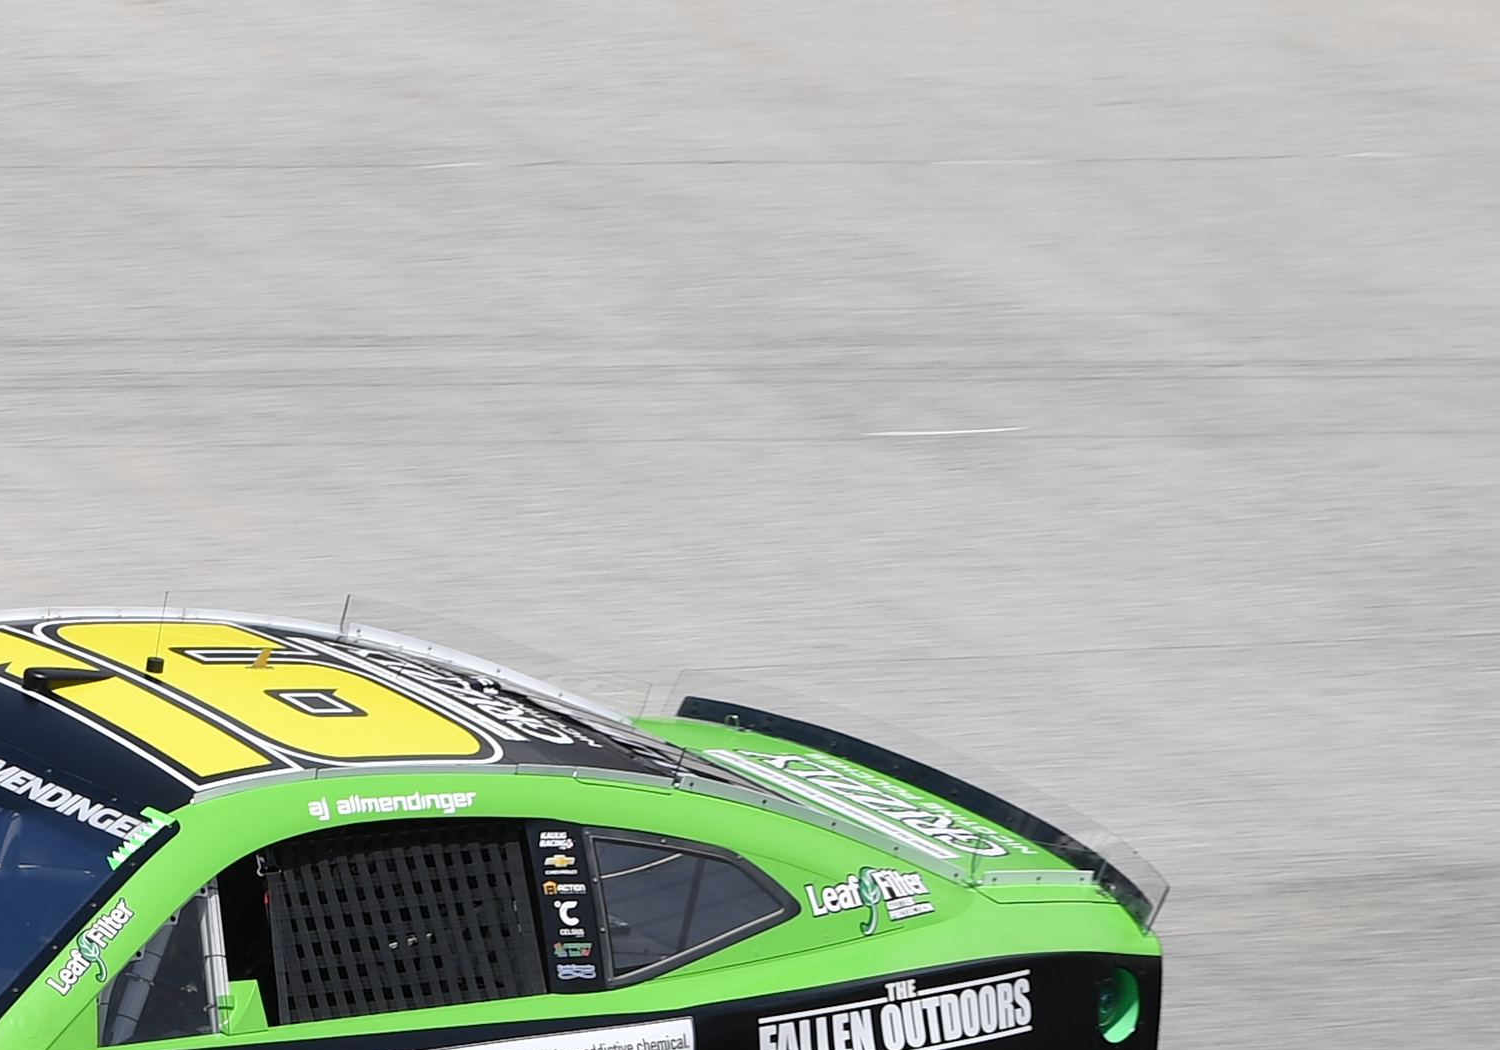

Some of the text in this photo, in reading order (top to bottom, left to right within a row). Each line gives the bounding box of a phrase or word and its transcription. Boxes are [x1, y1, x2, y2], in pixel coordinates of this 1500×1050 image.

[307, 791, 477, 821] aj allmendinger
[734, 748, 1011, 857] GRIZZLY
[884, 979, 918, 1002] THE
